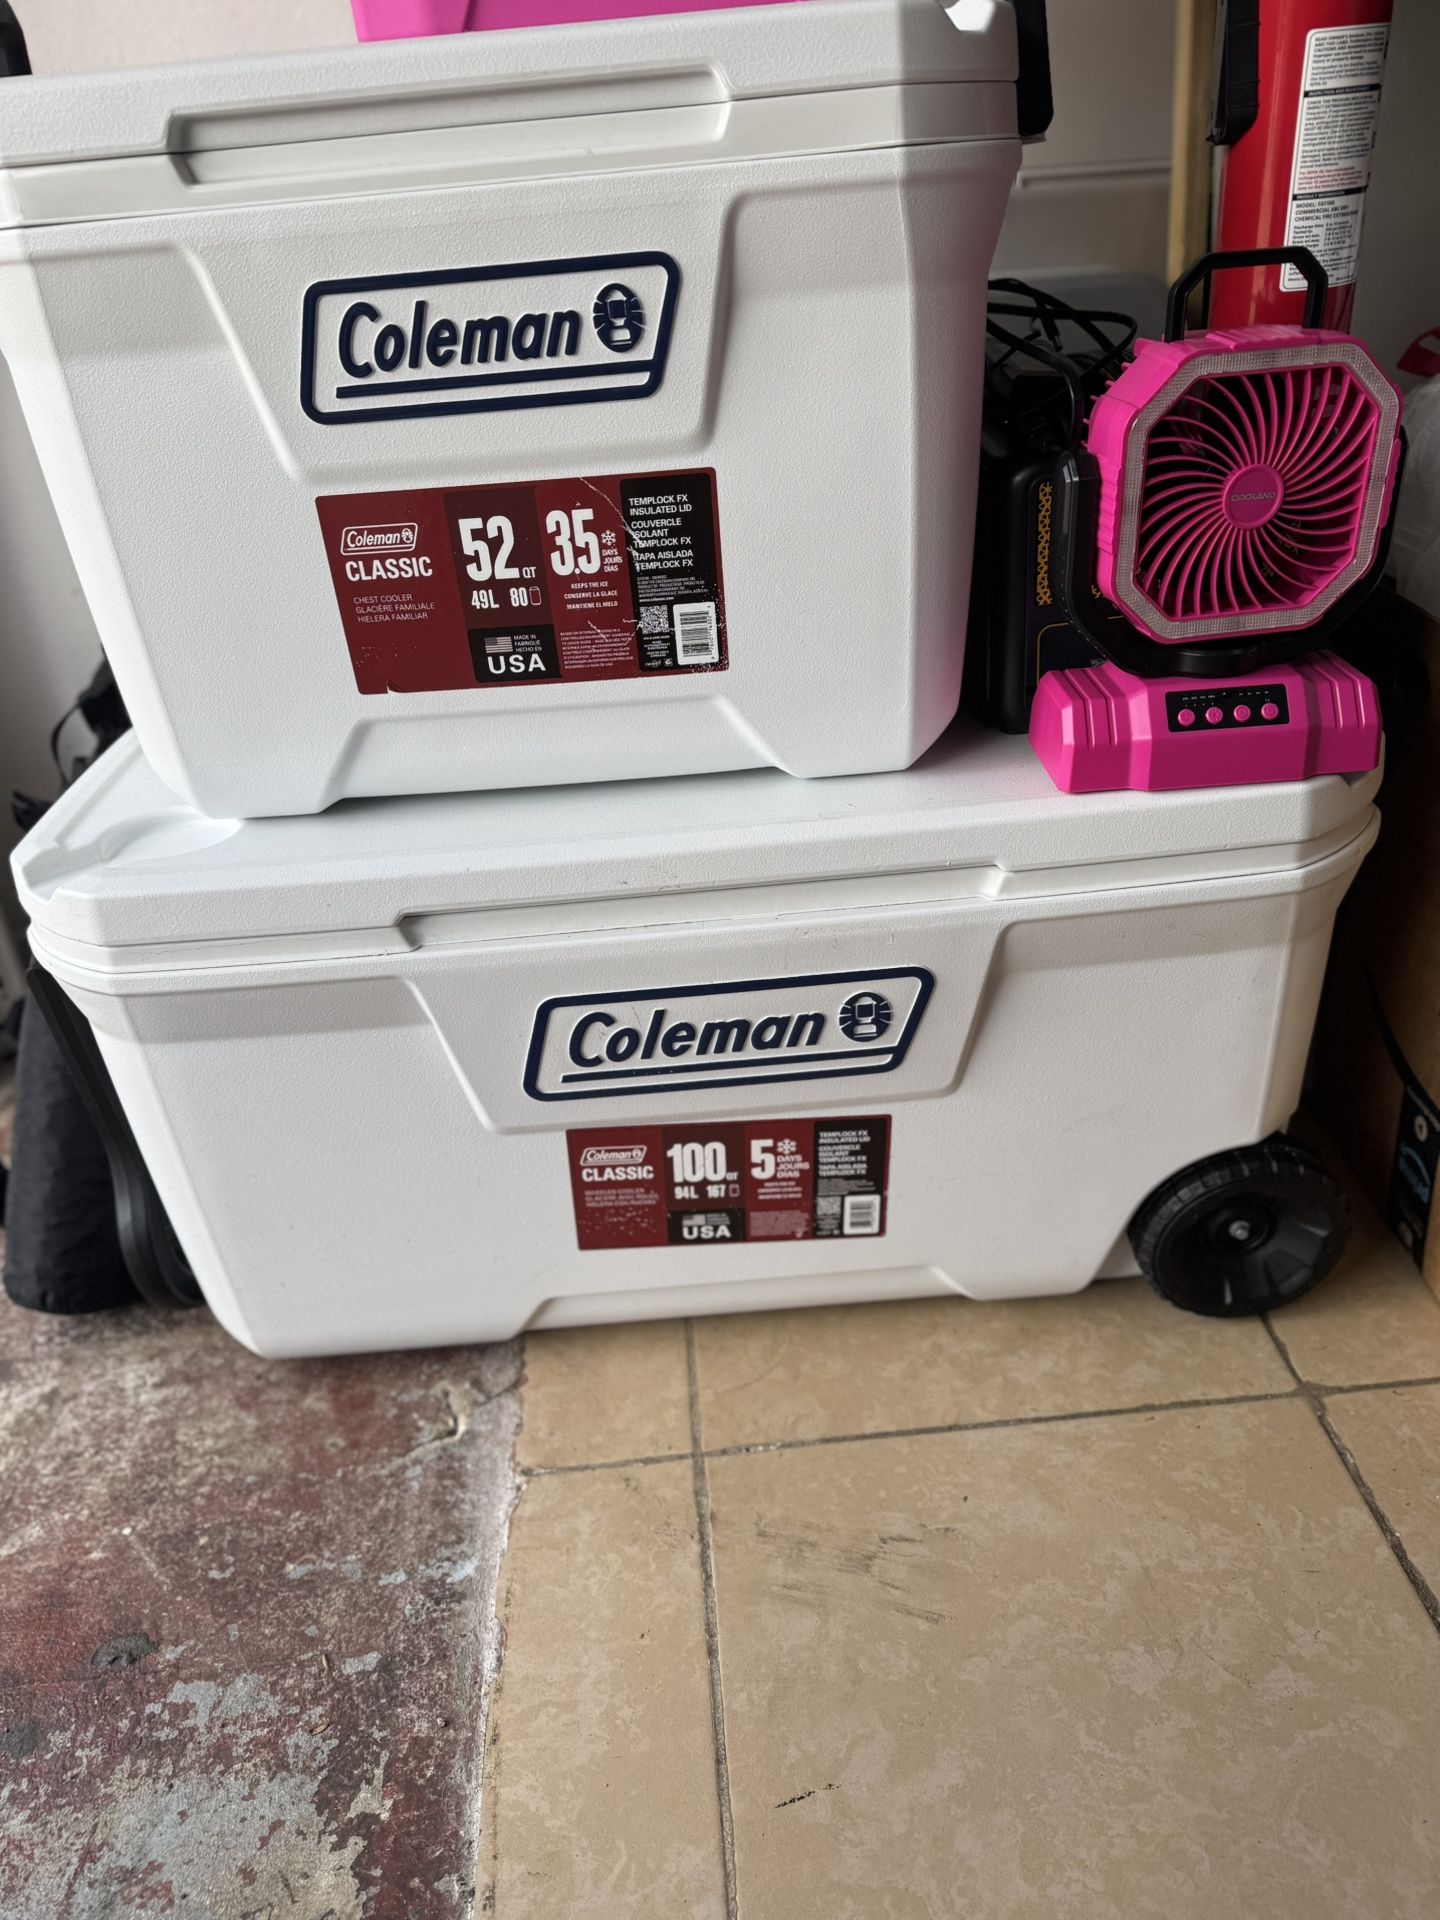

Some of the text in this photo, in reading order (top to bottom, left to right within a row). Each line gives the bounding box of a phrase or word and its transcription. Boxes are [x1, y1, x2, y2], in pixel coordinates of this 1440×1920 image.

[338, 300, 582, 379] Coleman
[629, 493, 689, 506] TEMPLOCK FX
[629, 503, 692, 516] INSULATED LID
[631, 517, 682, 529] COUVERCLE
[346, 529, 401, 548] Coleman
[545, 508, 601, 577] 3.5
[633, 536, 692, 548] TEMPLOCK FX
[458, 515, 537, 582] 52 QT
[602, 548, 619, 557] DAYS
[636, 549, 694, 561] TAPA AISLADA
[345, 556, 433, 582] CLASSIC
[636, 558, 694, 571] TEMPLOCK FX
[599, 580, 609, 588] ICE
[353, 593, 413, 605] CHEST COOLER
[509, 586, 528, 608] 80
[564, 589, 619, 600] CONSERVE LA GLACE
[395, 602, 436, 611] FAMILIALE
[566, 602, 595, 610] MANTIENE
[603, 600, 619, 608] HIELO
[357, 612, 429, 623] HIELERA FAMILIAR
[487, 653, 547, 675] USA
[568, 1009, 826, 1068] Coleman
[586, 1149, 631, 1161] Coleman
[751, 1139, 775, 1180] 5
[777, 1154, 802, 1163] DAYS
[666, 1141, 727, 1183] 100
[777, 1162, 810, 1171] JOURS
[582, 1165, 655, 1182] CLASSIC
[706, 1184, 726, 1199] 167
[682, 1225, 732, 1240] USA
